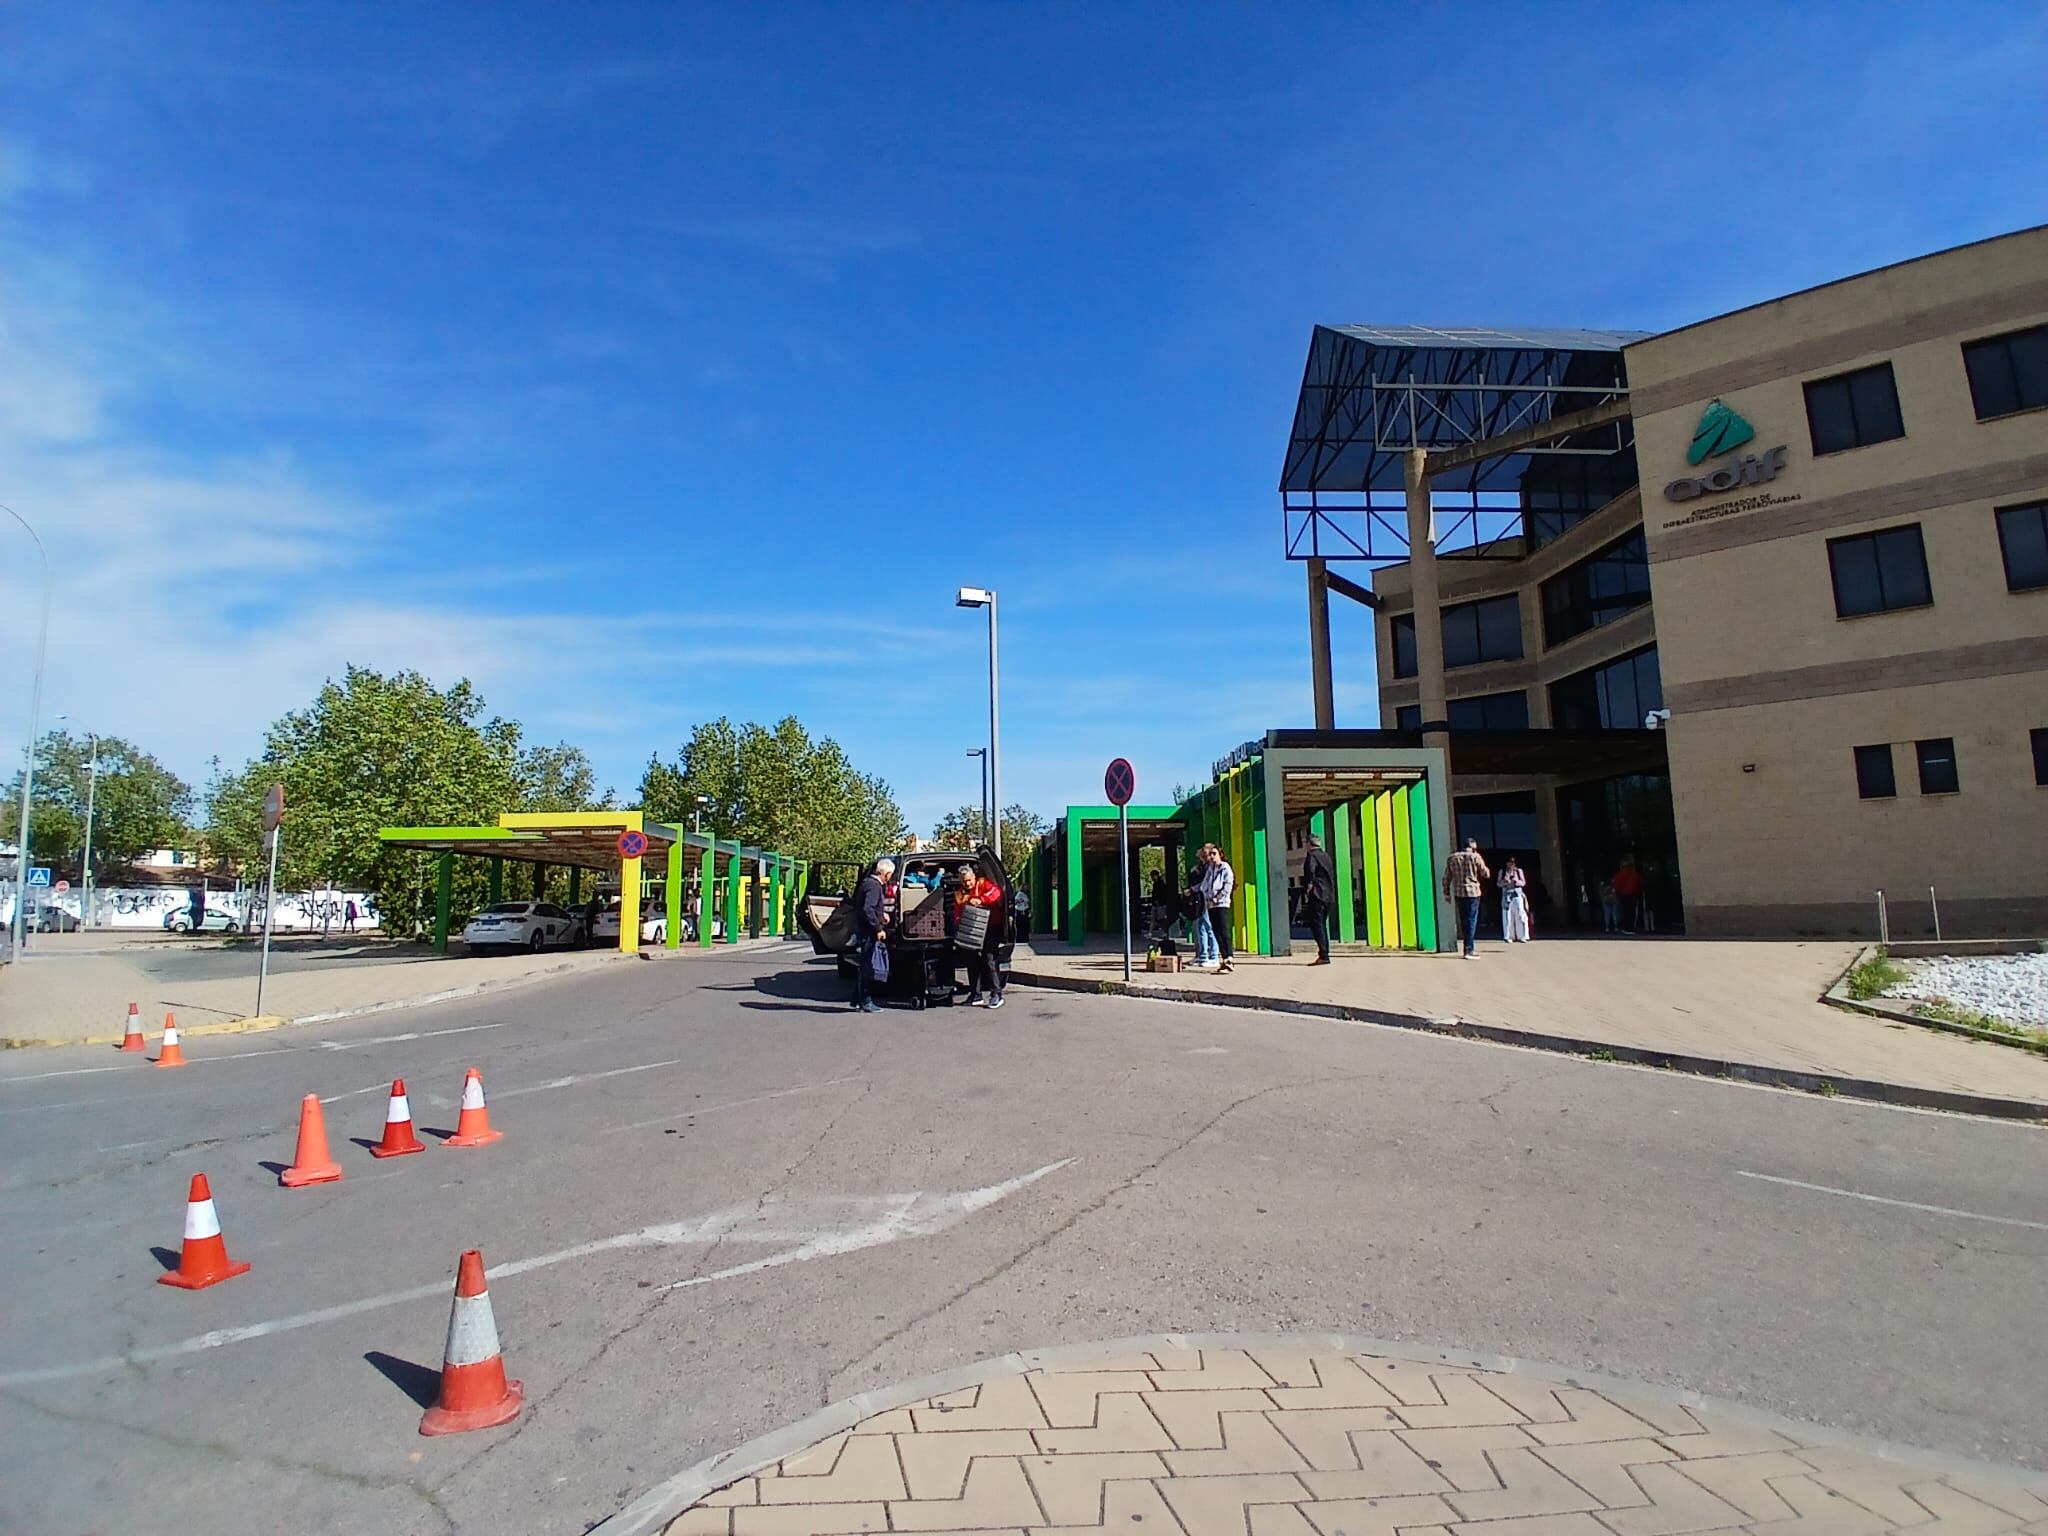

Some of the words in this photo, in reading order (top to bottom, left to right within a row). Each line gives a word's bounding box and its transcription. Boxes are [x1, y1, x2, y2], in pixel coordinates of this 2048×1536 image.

[1664, 445, 1787, 502] adif
[1663, 508, 1740, 528] INFRAESTRUCTURAS
[1743, 494, 1801, 511] FERROVIARIAS
[1691, 497, 1756, 515] ADMINISTRADOR
[1760, 493, 1770, 502] DE
